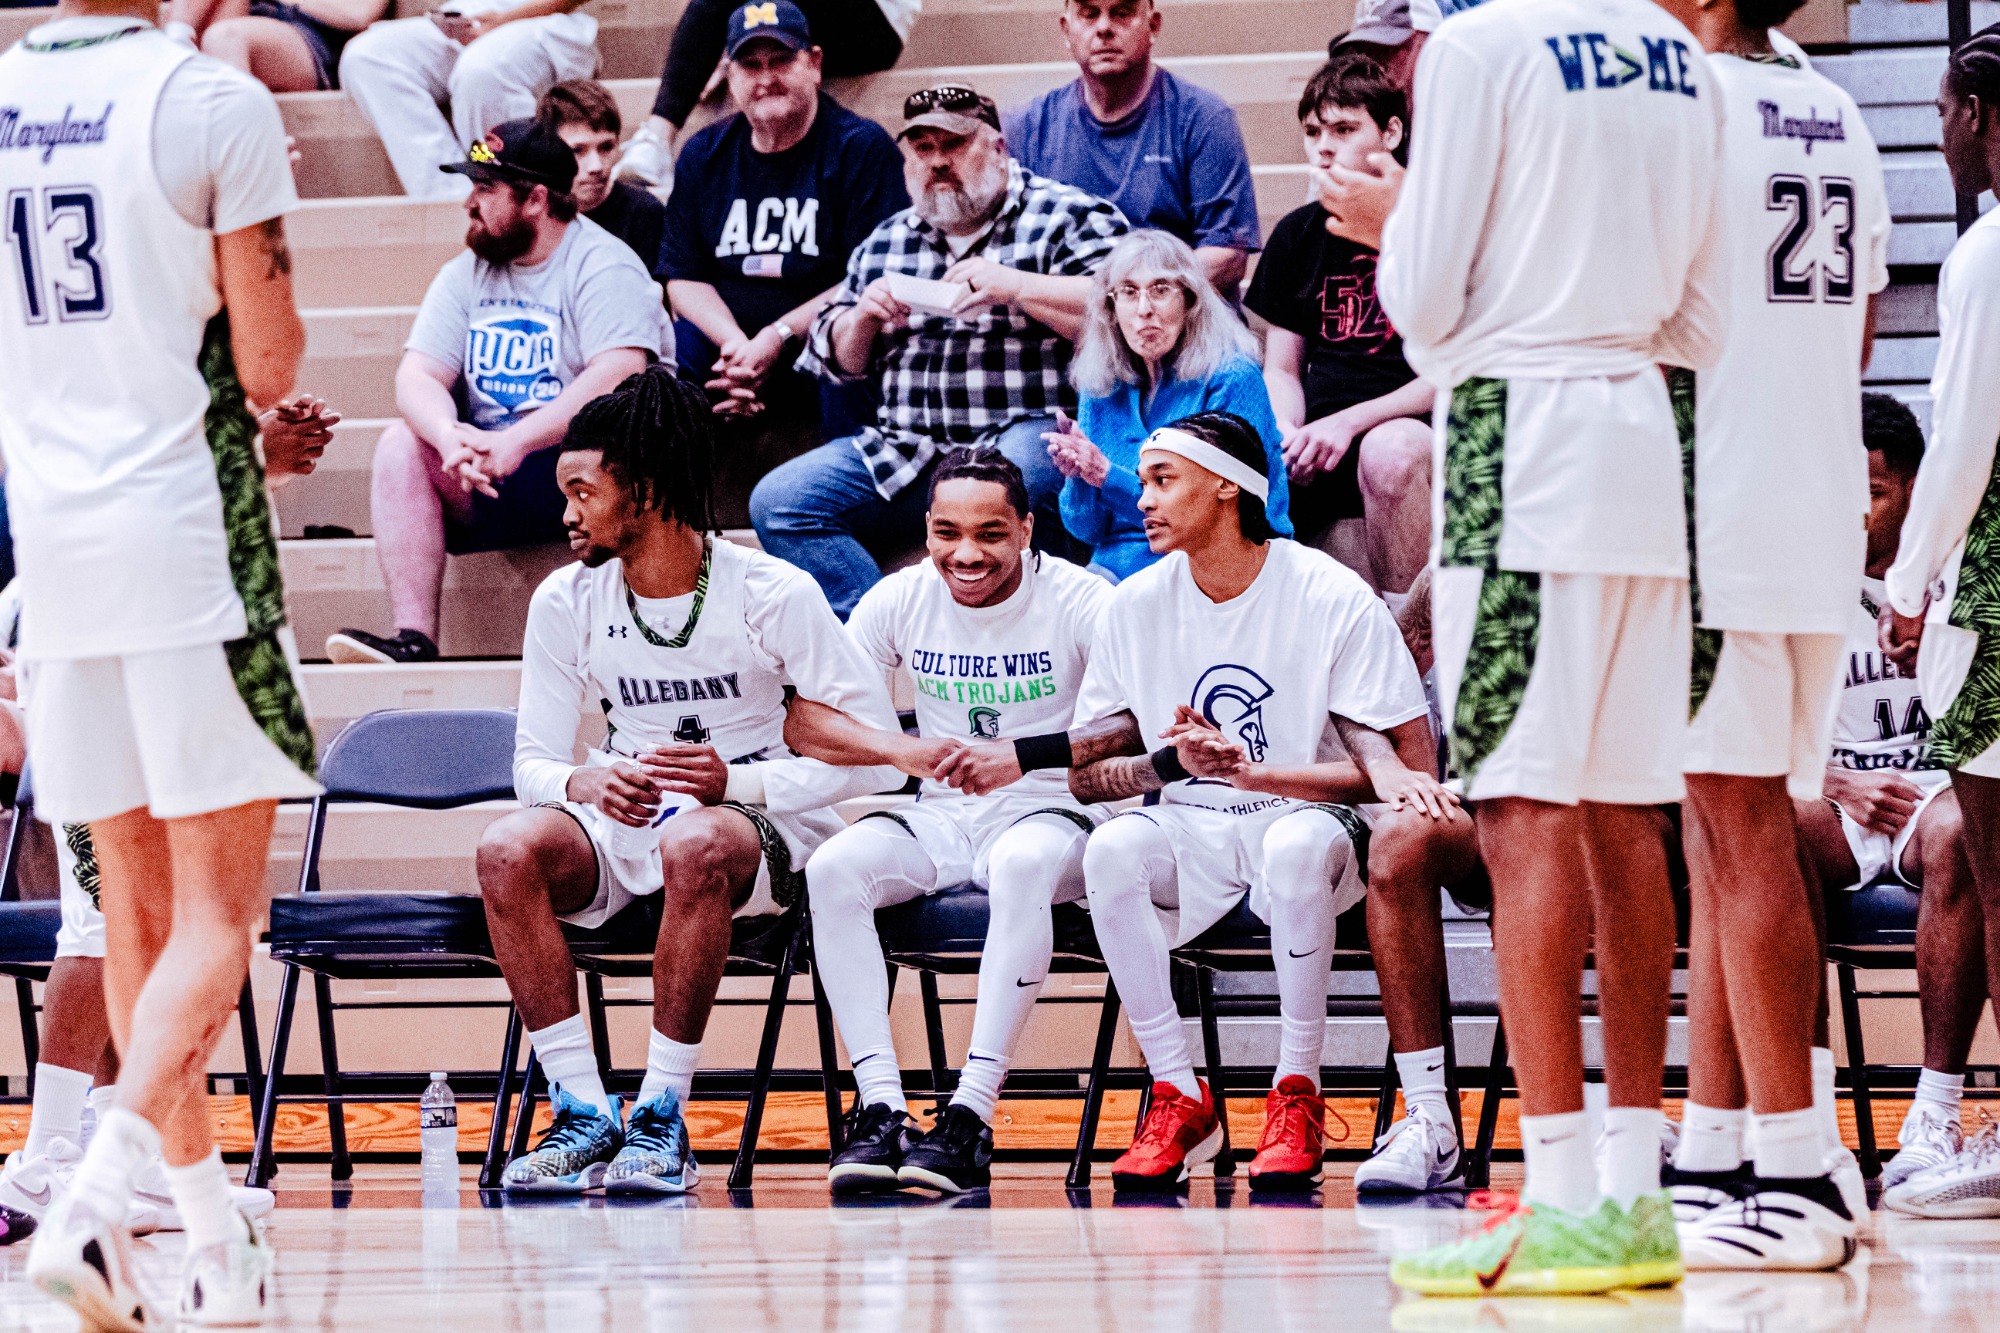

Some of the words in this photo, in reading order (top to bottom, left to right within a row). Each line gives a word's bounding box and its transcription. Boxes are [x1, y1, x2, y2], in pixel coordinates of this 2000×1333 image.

[743, 2, 780, 30] M
[0, 101, 113, 164] Maryland
[1758, 101, 1846, 156] Maryland
[715, 197, 820, 258] ACM
[1767, 174, 1857, 304] 23
[6, 184, 113, 325] 13
[911, 649, 998, 678] CULTURE
[1002, 650, 1053, 677] WINS
[618, 672, 742, 707] ALLEGANY
[917, 674, 951, 701] ACM
[953, 675, 1057, 704] TROJANS
[670, 714, 711, 744] 4
[1874, 695, 1932, 740] 14
